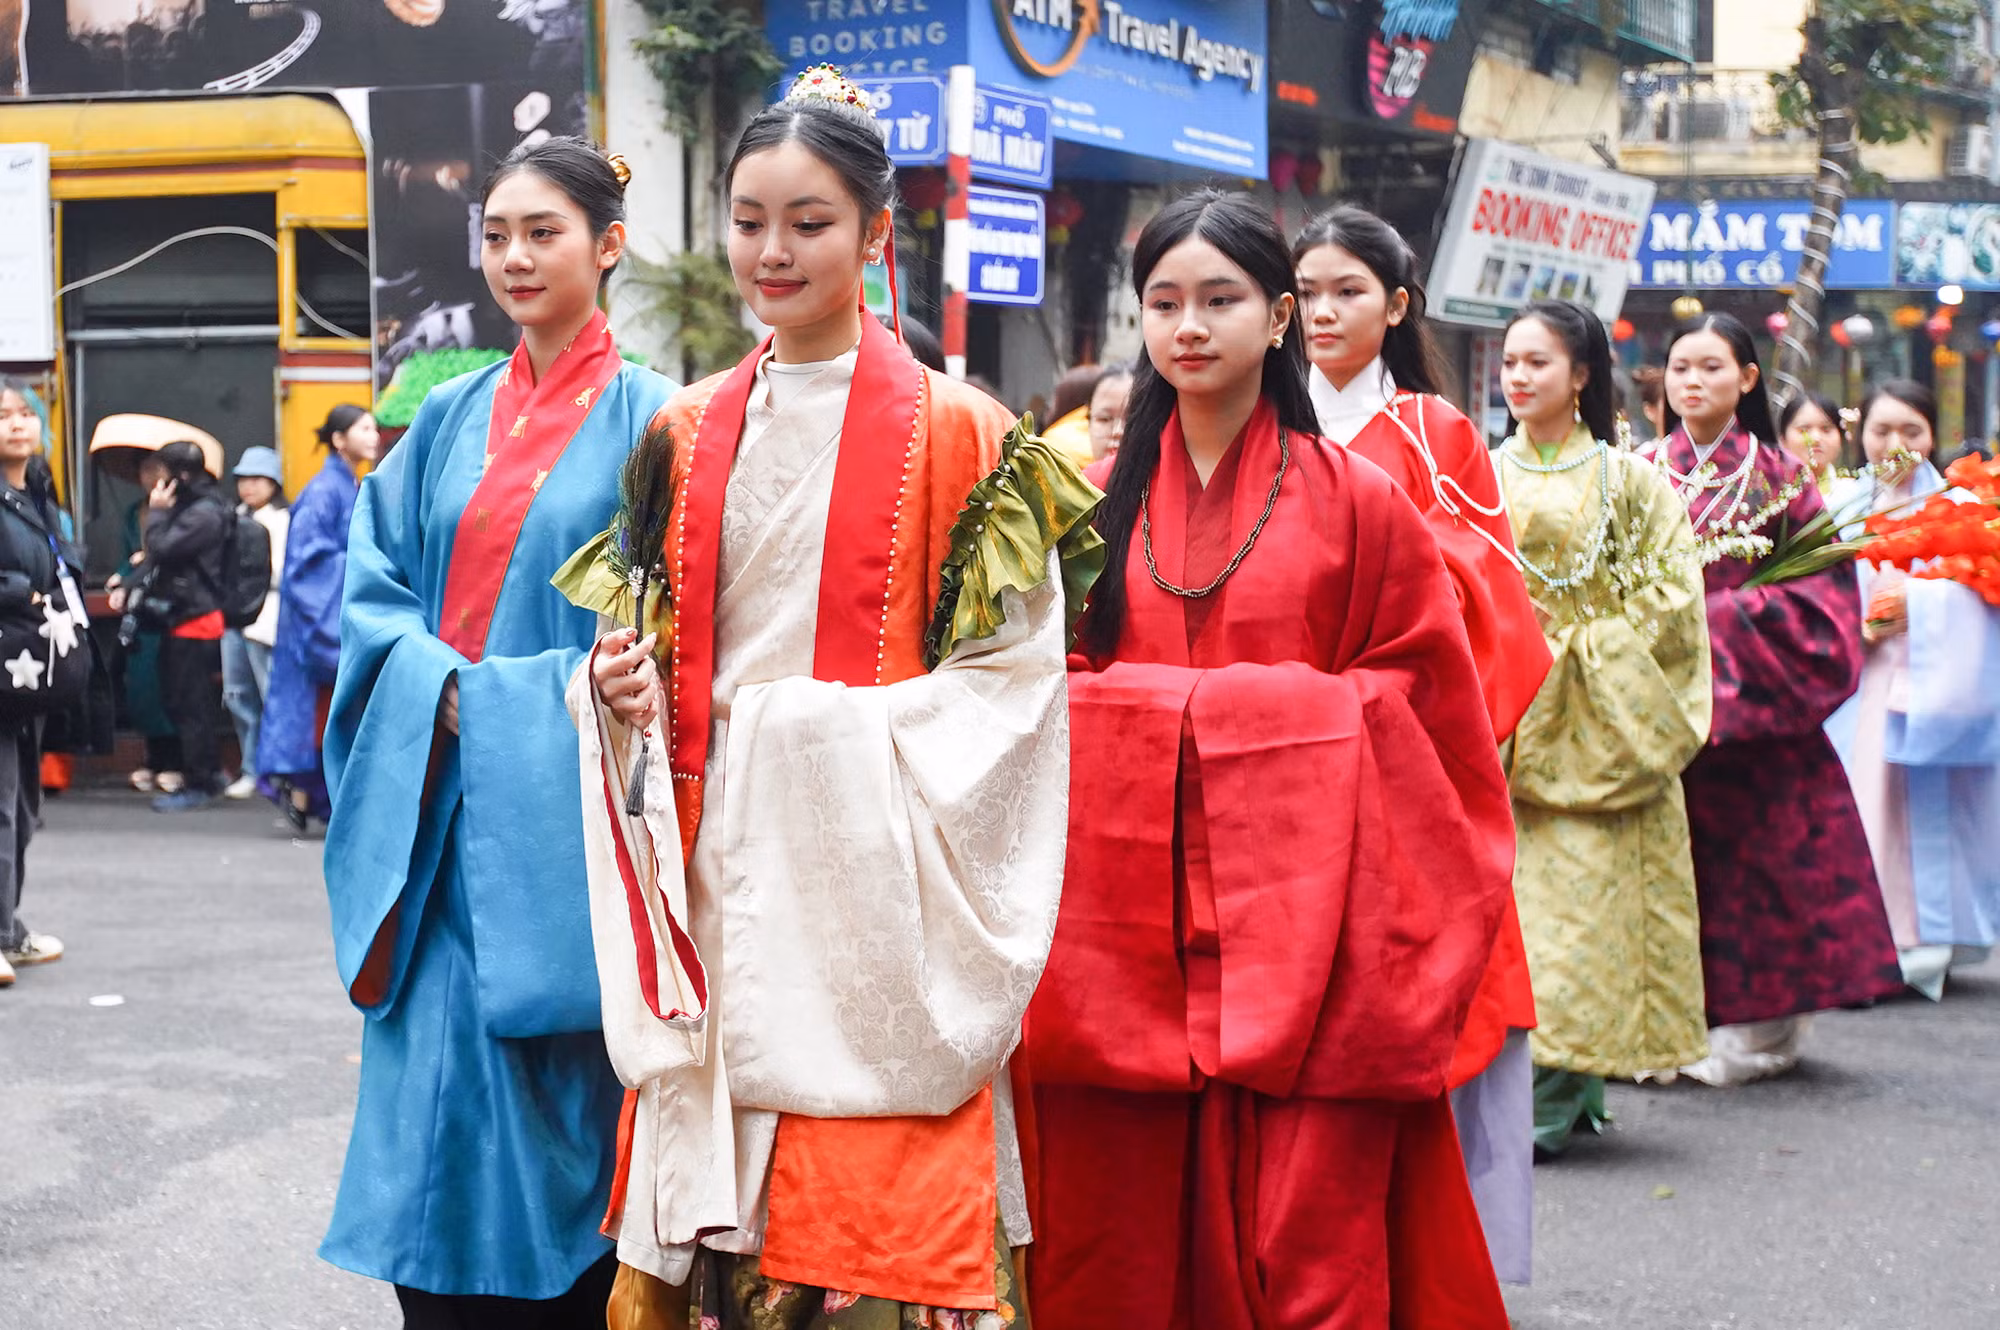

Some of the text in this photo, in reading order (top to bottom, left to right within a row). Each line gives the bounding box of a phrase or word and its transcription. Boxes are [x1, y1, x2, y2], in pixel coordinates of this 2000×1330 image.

[789, 21, 948, 58] BOOKING
[1104, 1, 1179, 61] Travel
[1183, 25, 1264, 94] Agency
[1472, 187, 1568, 248] BOOKING
[1570, 210, 1638, 260] OFFICE
